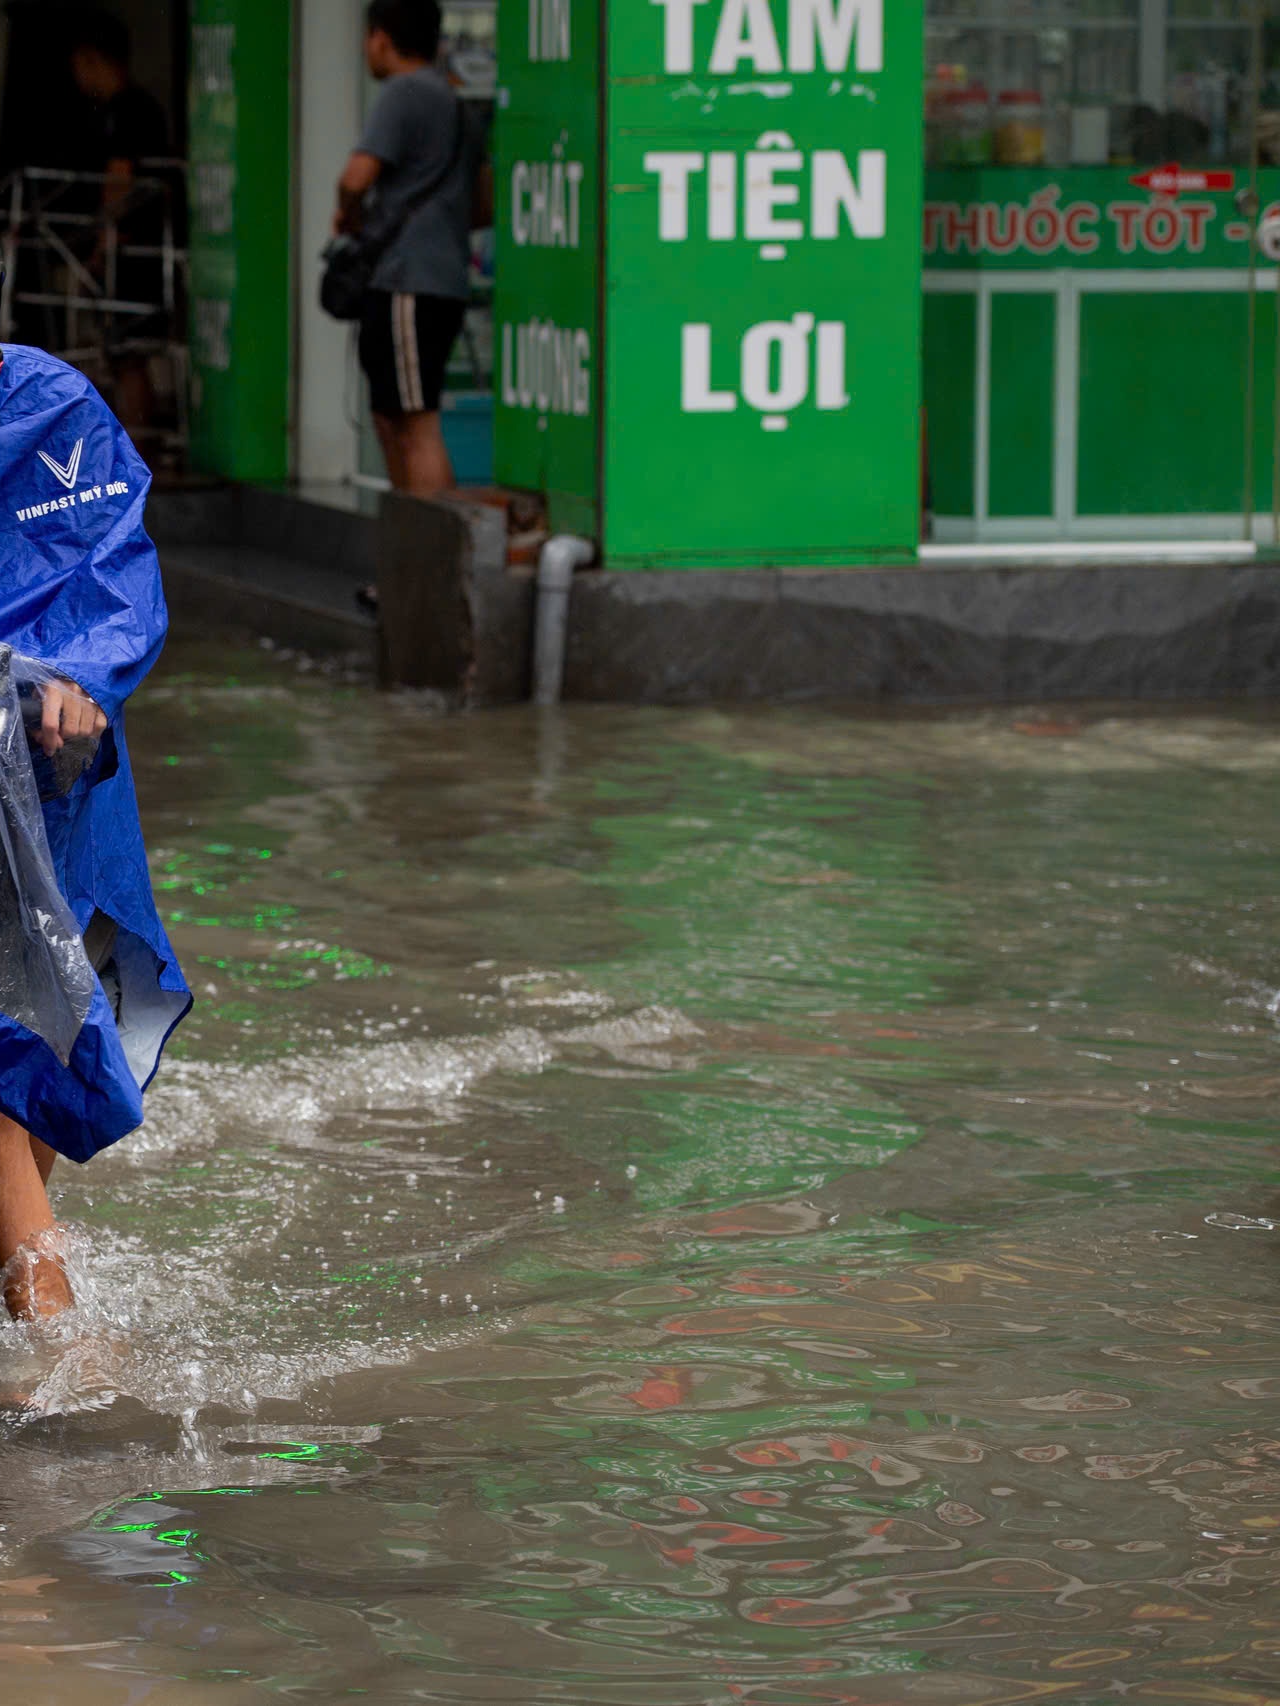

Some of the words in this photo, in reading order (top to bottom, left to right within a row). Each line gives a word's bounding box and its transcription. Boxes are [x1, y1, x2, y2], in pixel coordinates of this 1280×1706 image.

[511, 129, 583, 248] CHẤT
[643, 131, 886, 260] TIỆN
[922, 183, 1100, 255] THUỐC
[681, 312, 849, 431] LỢI
[16, 494, 76, 522] VINFAST
[79, 485, 102, 503] MỸ
[106, 480, 129, 496] ĐỨC
